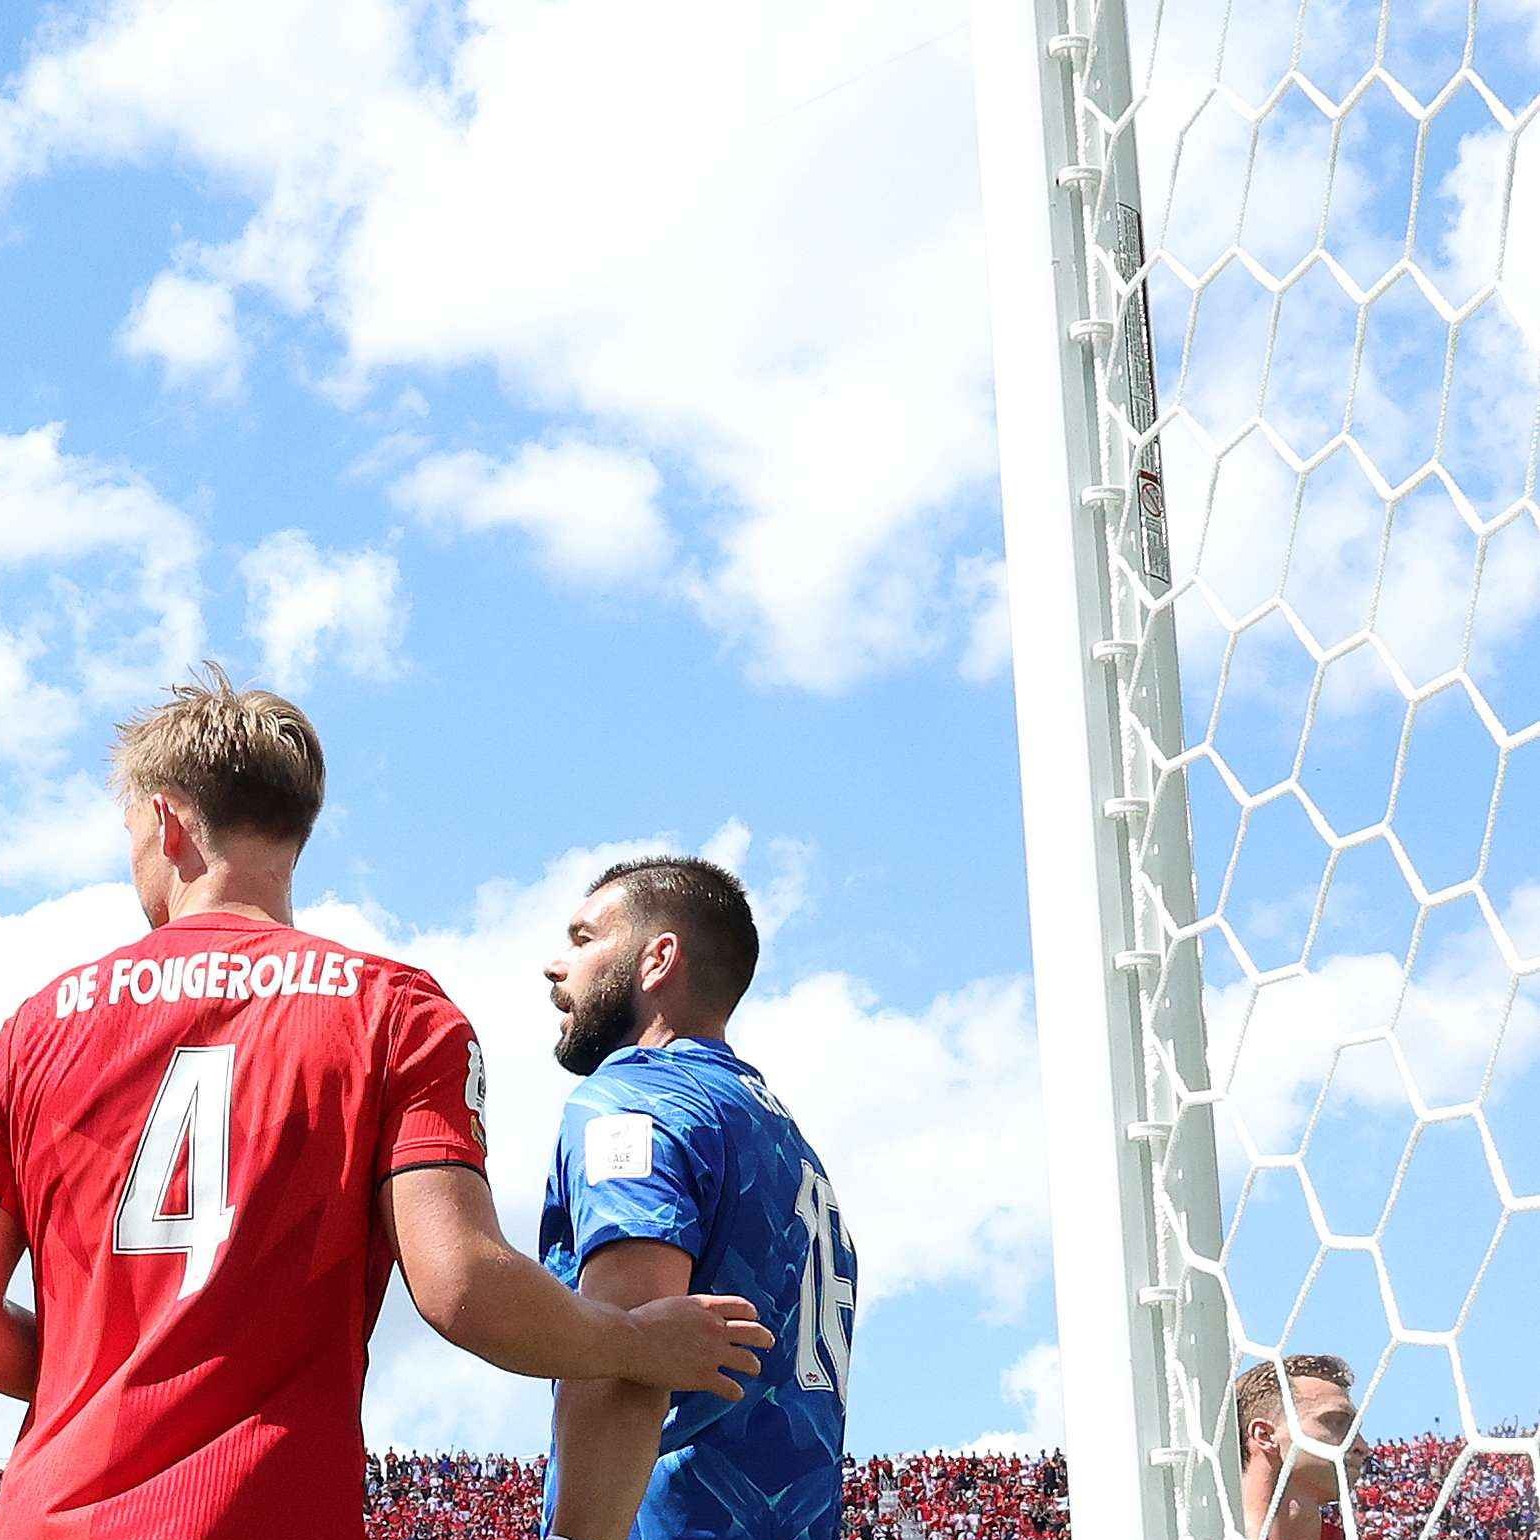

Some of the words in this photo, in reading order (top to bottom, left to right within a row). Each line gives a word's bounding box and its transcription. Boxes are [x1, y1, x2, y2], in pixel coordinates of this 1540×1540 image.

[56, 965, 98, 1018] DE
[108, 950, 365, 1005] FOUGEROLLES
[112, 1043, 237, 1301] 4
